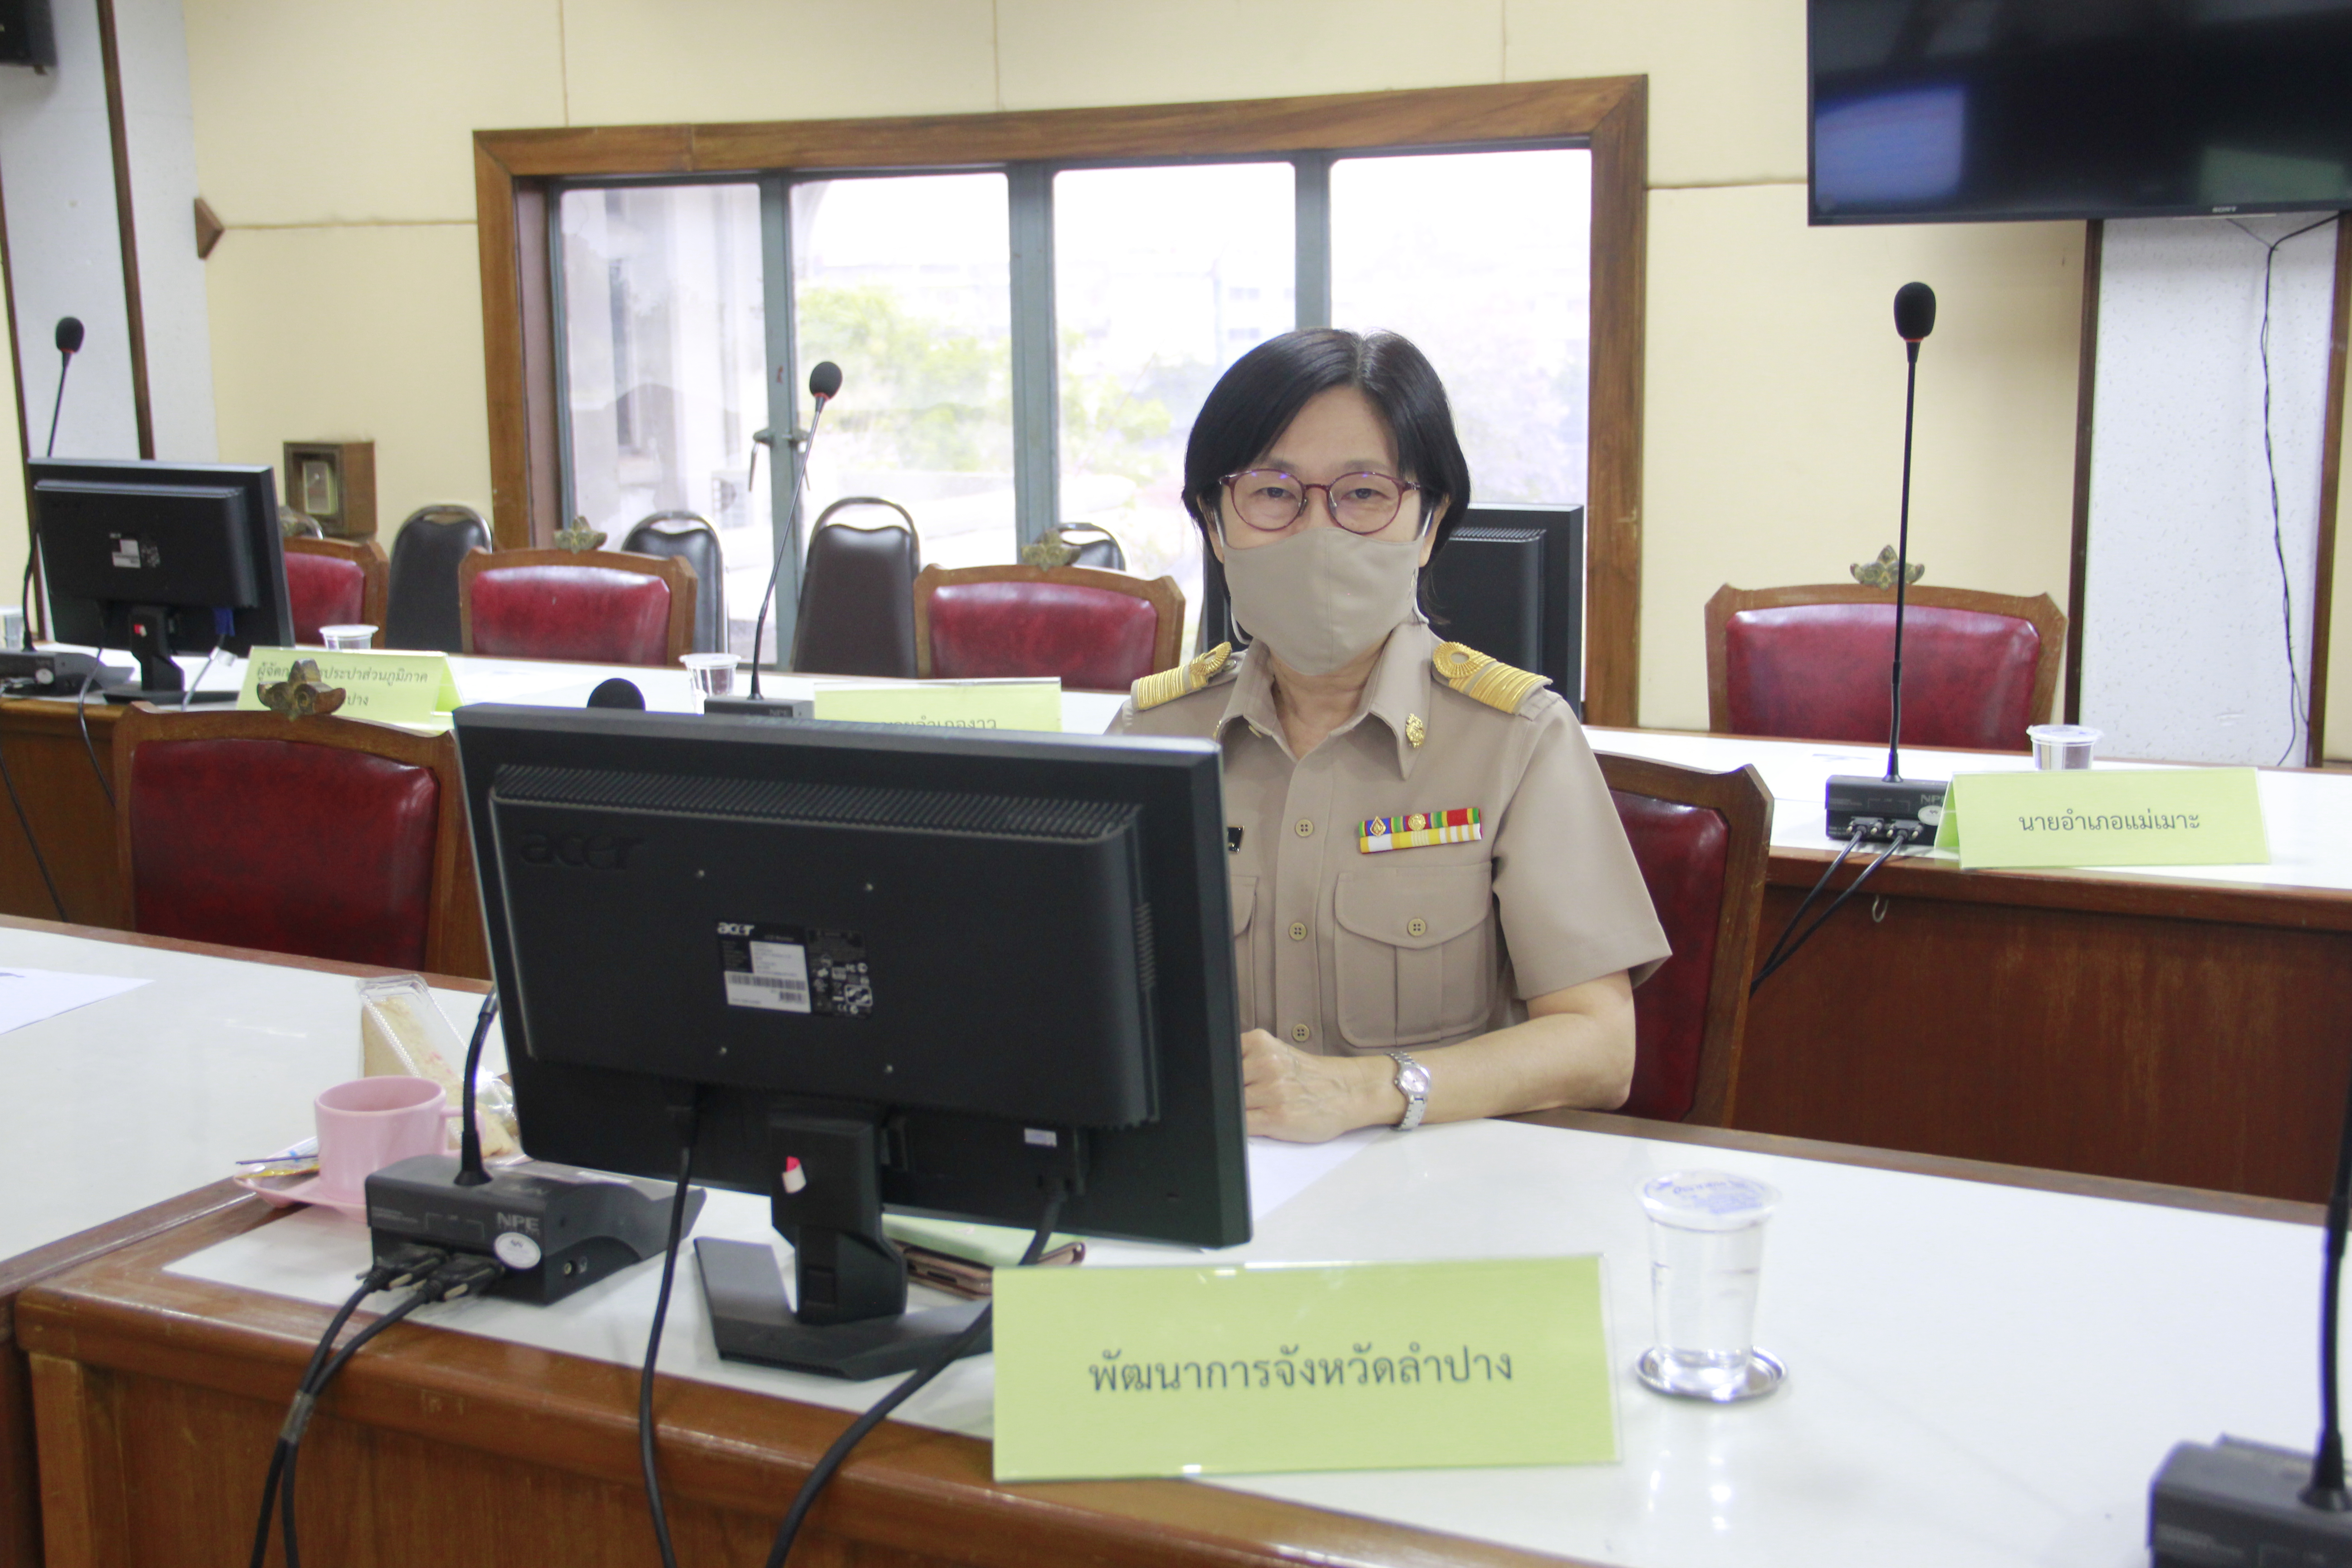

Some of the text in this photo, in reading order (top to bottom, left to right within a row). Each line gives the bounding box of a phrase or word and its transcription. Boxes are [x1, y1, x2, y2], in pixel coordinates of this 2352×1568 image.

[2019, 808, 2200, 832] นายอำเภอแม่เมาะ
[520, 833, 645, 869] acer
[716, 922, 755, 936] acer
[496, 1212, 540, 1232] NPE
[1088, 1341, 1514, 1393] พัฒนาการจังหวัดลำปาง
